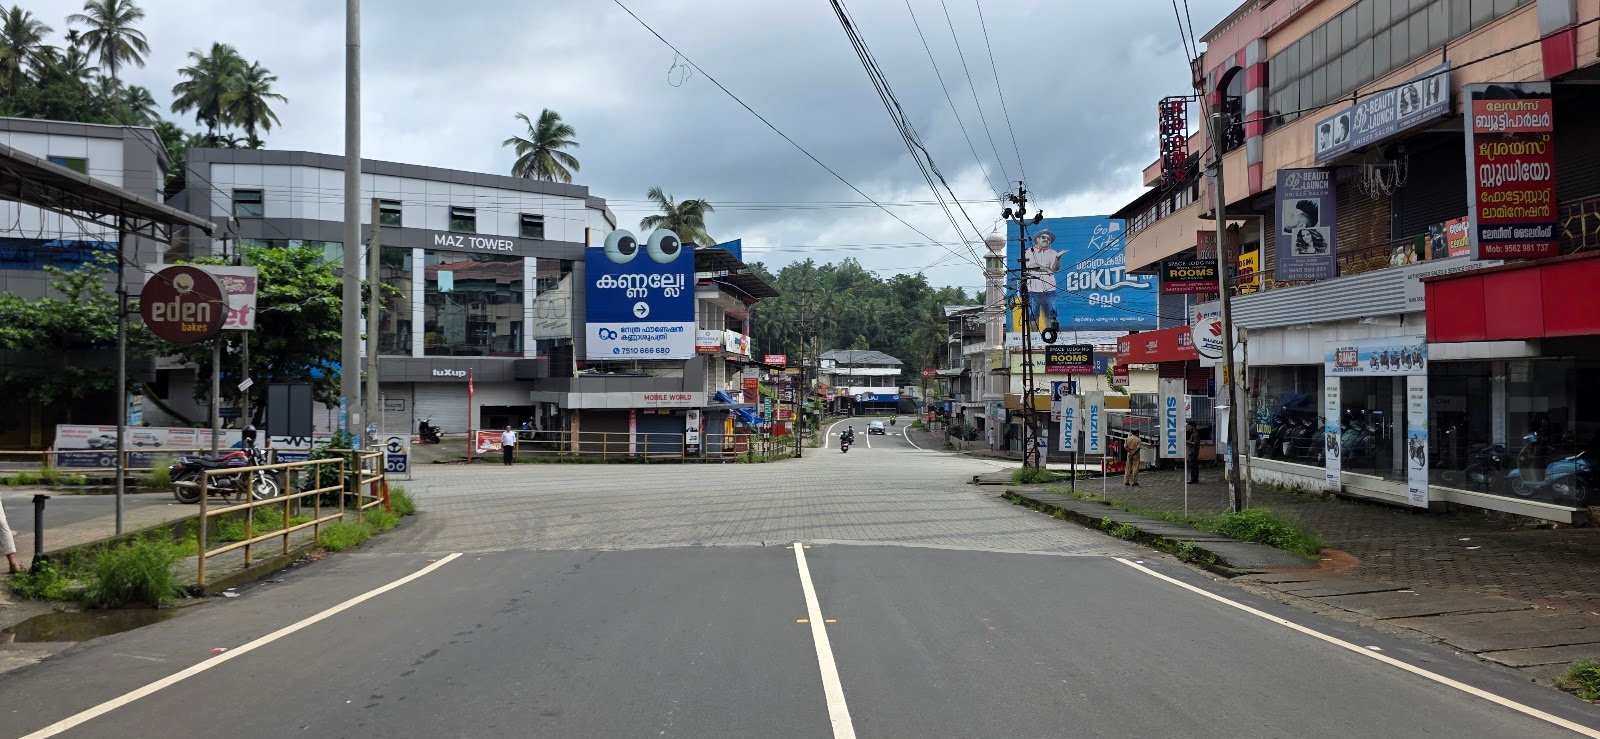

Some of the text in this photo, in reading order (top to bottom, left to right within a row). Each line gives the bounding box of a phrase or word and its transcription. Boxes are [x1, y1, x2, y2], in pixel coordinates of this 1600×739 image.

[1370, 91, 1395, 113] BEAUTY
[1486, 100, 1539, 111] ലേഡീസ്
[1369, 107, 1394, 130] LAUNCH
[1479, 134, 1550, 161] ശ്രേയസ്
[1303, 171, 1329, 181] BEAUTY
[1480, 160, 1551, 188] സ്റ്റുഡിയോ
[1303, 180, 1329, 190] LAUNCH
[1482, 204, 1550, 218] ലാമിനേഷൻ
[434, 234, 514, 251] MAZ TOWER
[1485, 243, 1549, 253] Mob: 9562 981 737
[1169, 268, 1214, 277] ROOMS
[151, 295, 211, 322] eden
[181, 323, 208, 332] bakes
[1064, 407, 1073, 449] SUZUKI
[1090, 405, 1098, 451] SUZUKI
[1166, 396, 1177, 455] SUZUKI
